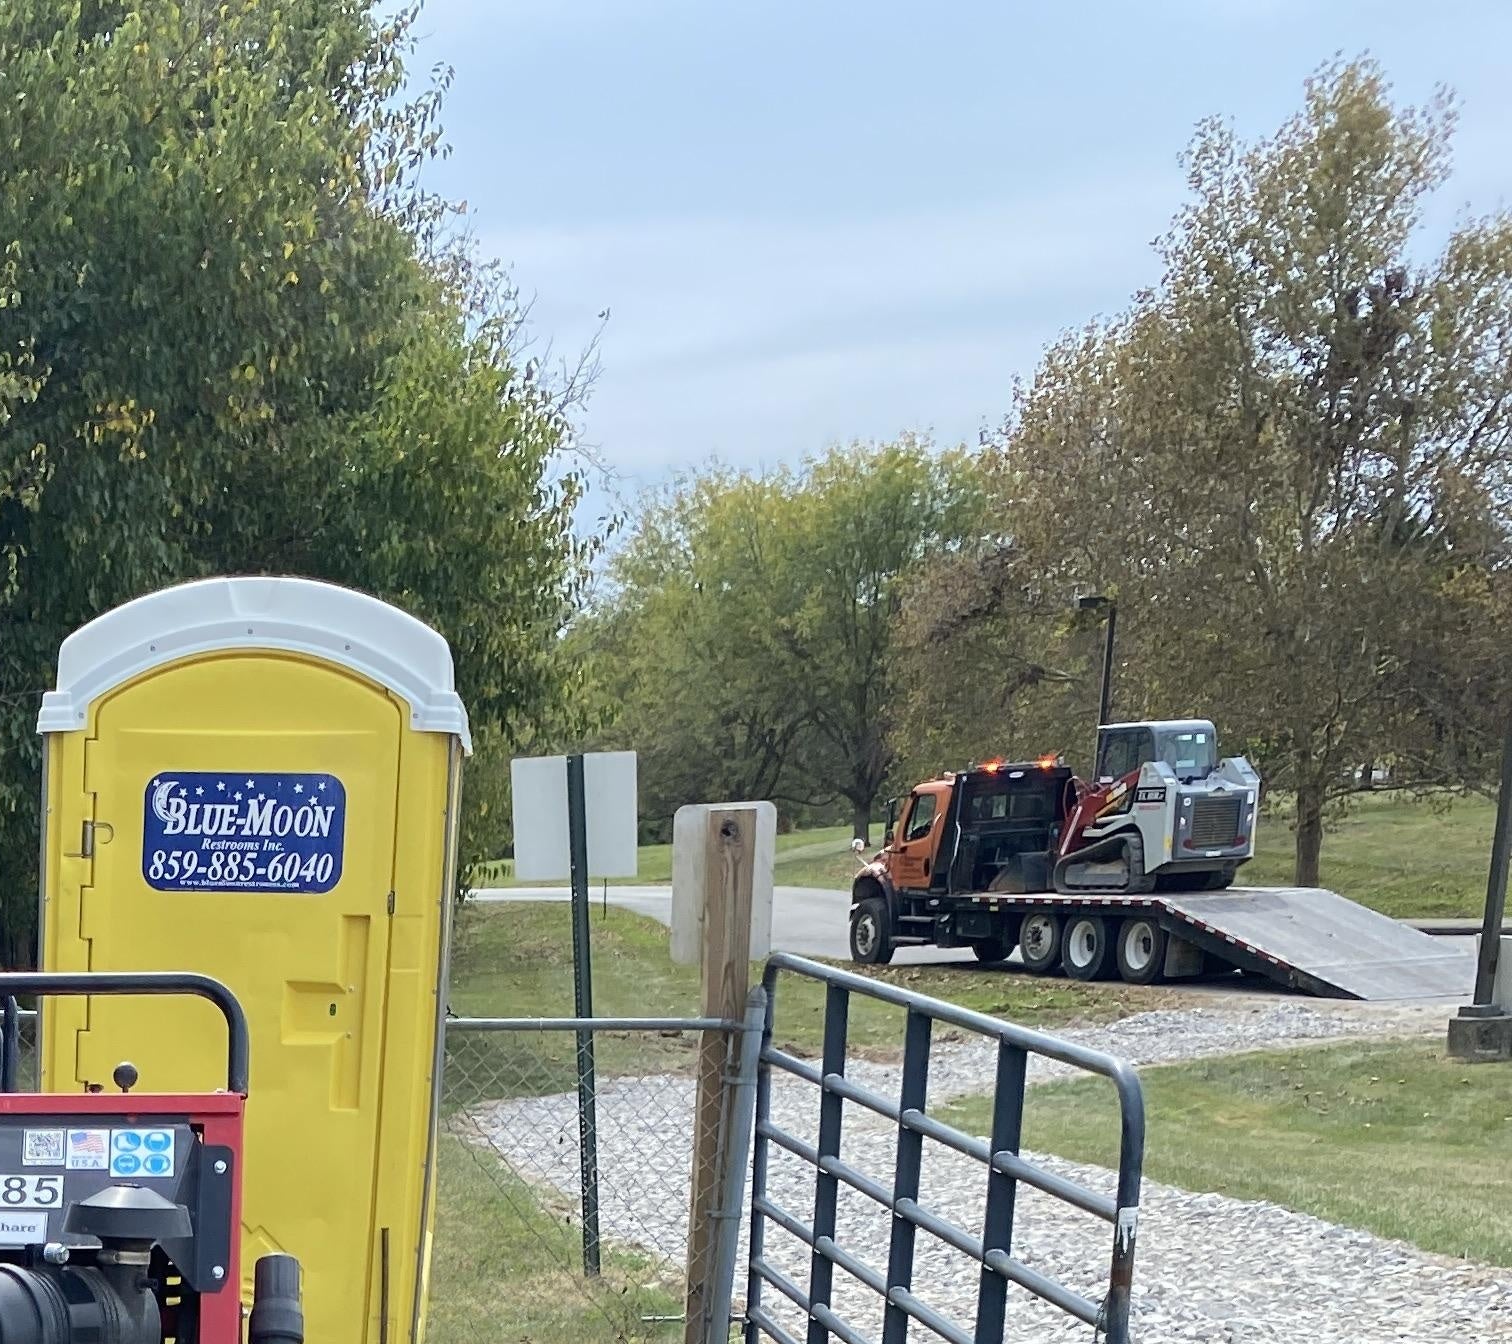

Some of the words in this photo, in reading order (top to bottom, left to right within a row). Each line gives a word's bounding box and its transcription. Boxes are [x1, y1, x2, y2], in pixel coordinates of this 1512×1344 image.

[163, 797, 336, 837] BLUE-MOON
[201, 838, 259, 851] Restrooms
[262, 839, 285, 851] Inc.
[148, 850, 334, 883] 859-885-6040
